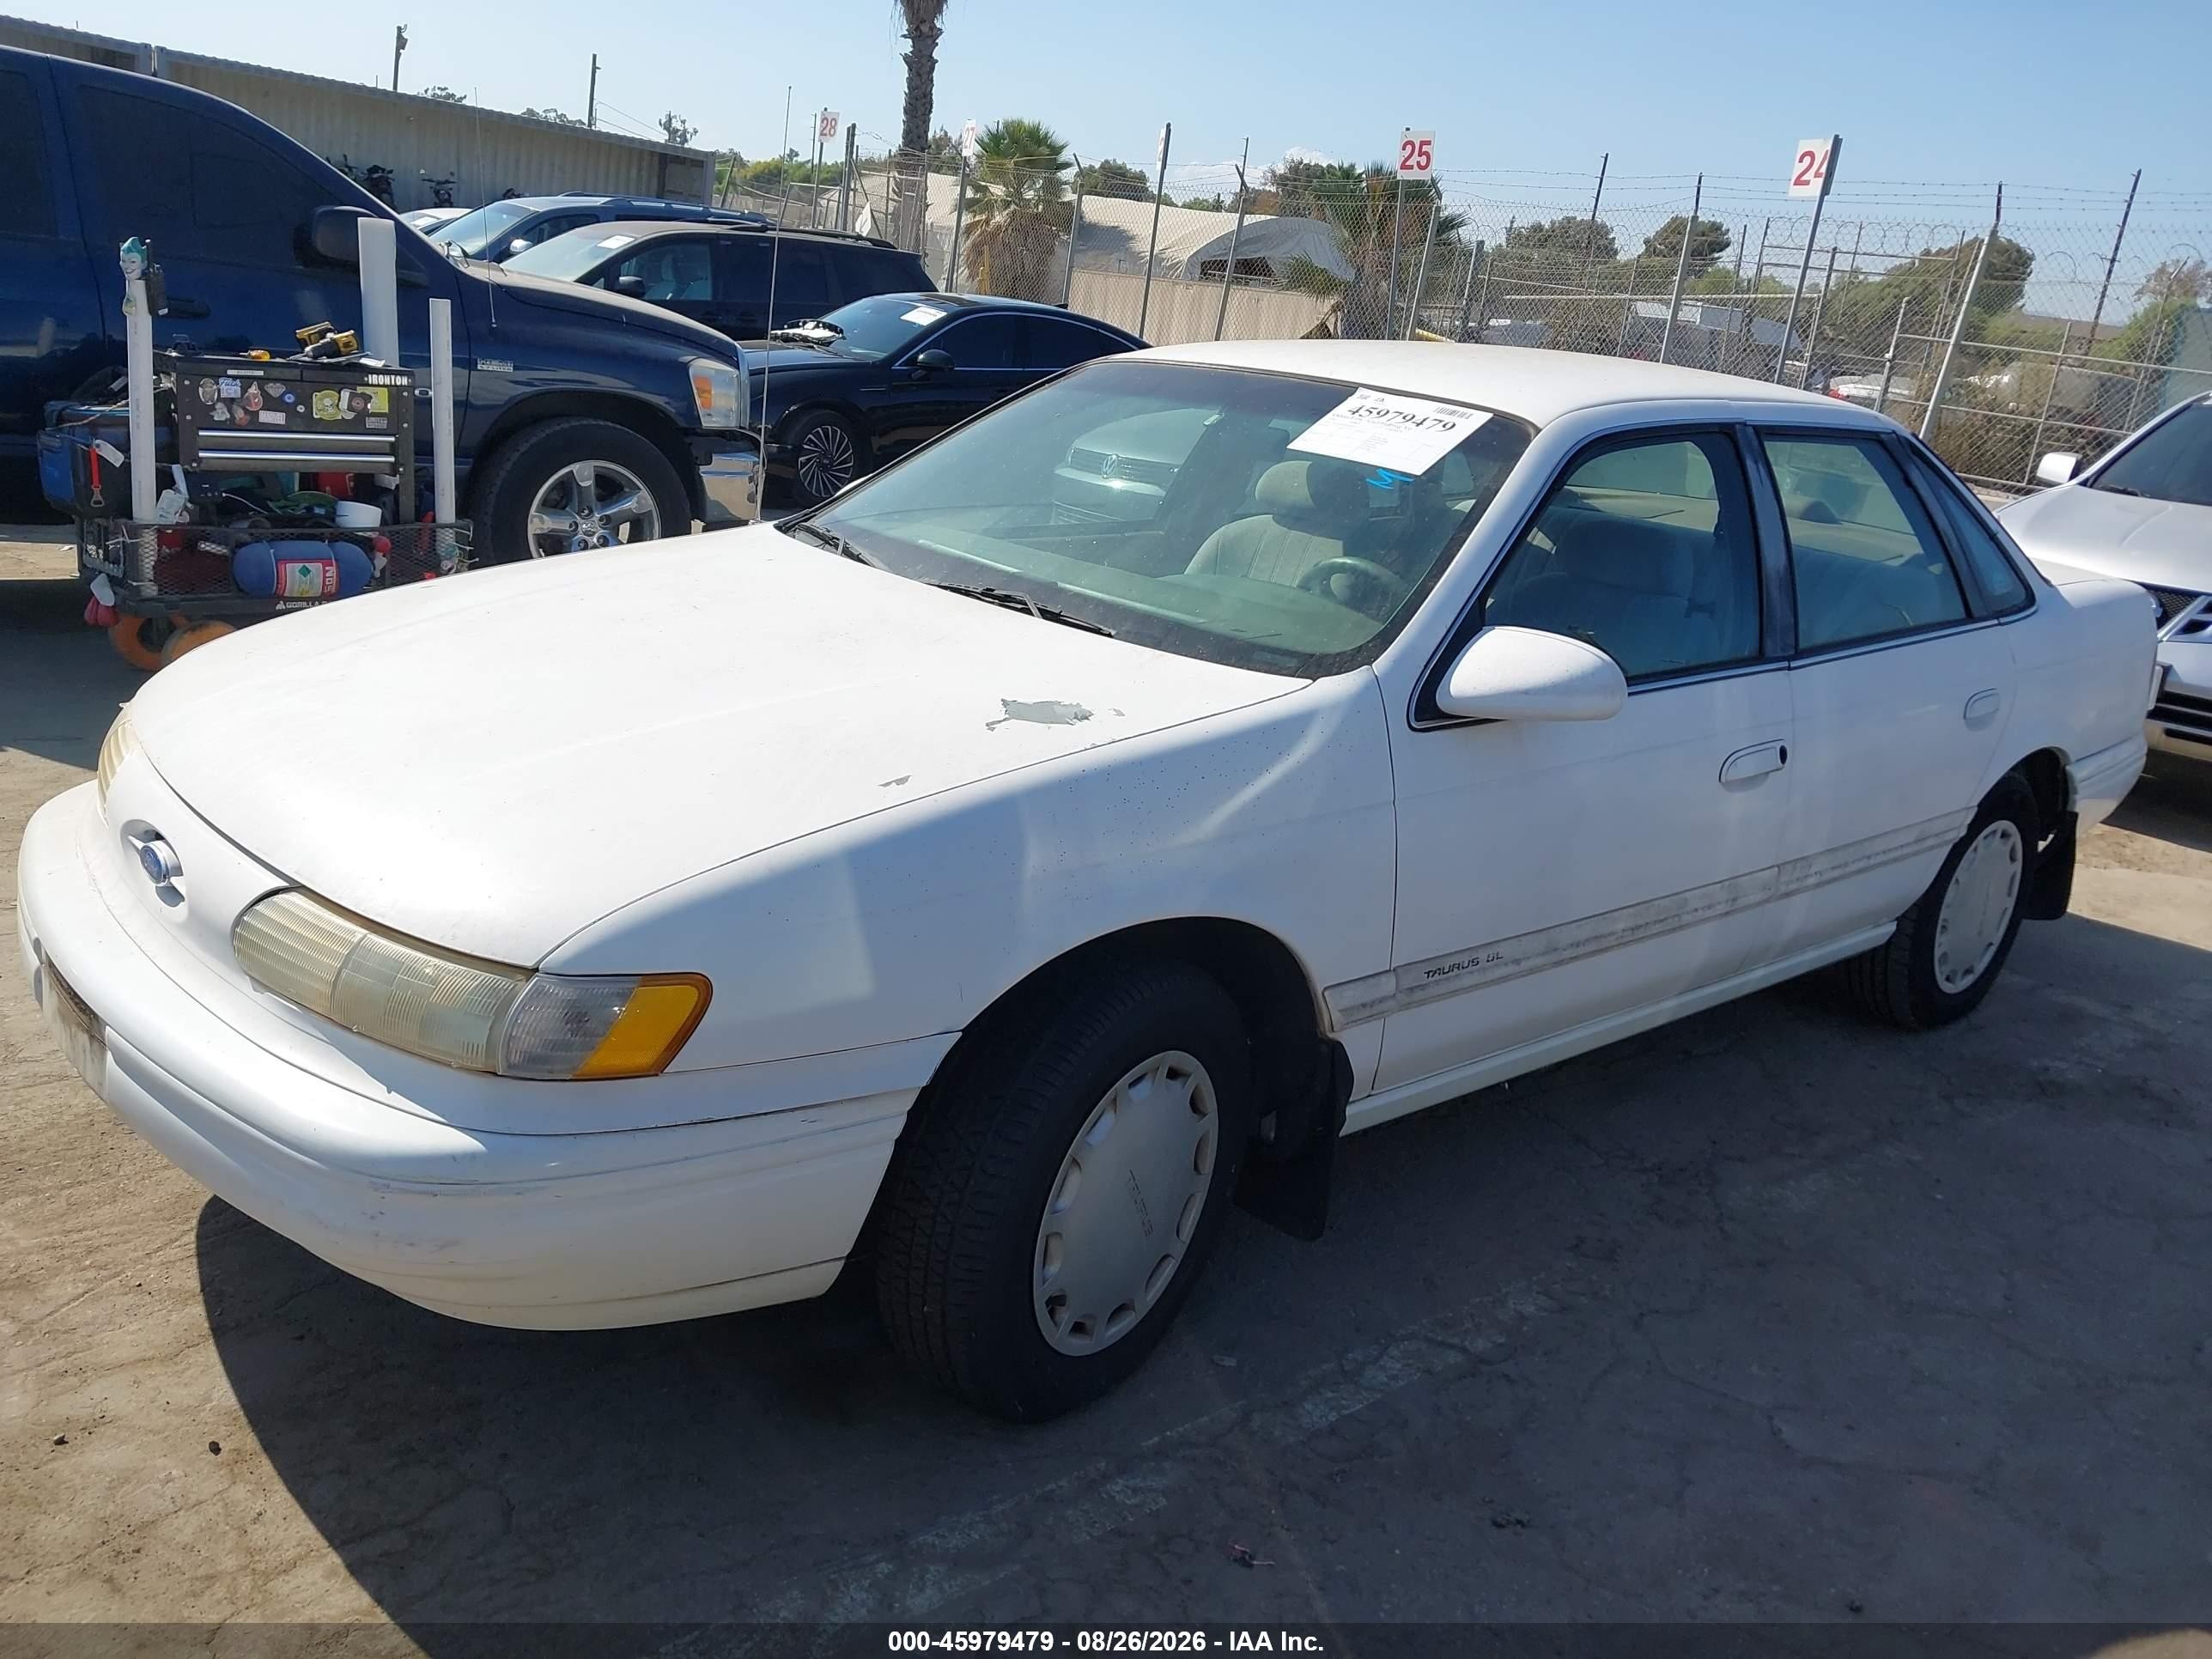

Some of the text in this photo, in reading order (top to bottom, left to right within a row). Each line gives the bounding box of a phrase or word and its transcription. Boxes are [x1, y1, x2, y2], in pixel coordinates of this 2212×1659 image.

[819, 118, 838, 137] 28
[963, 127, 975, 149] 27
[1400, 140, 1432, 171] 25
[368, 374, 408, 386] IRONTON
[1347, 404, 1456, 432] 45979479
[1424, 957, 1480, 979] TAURUS
